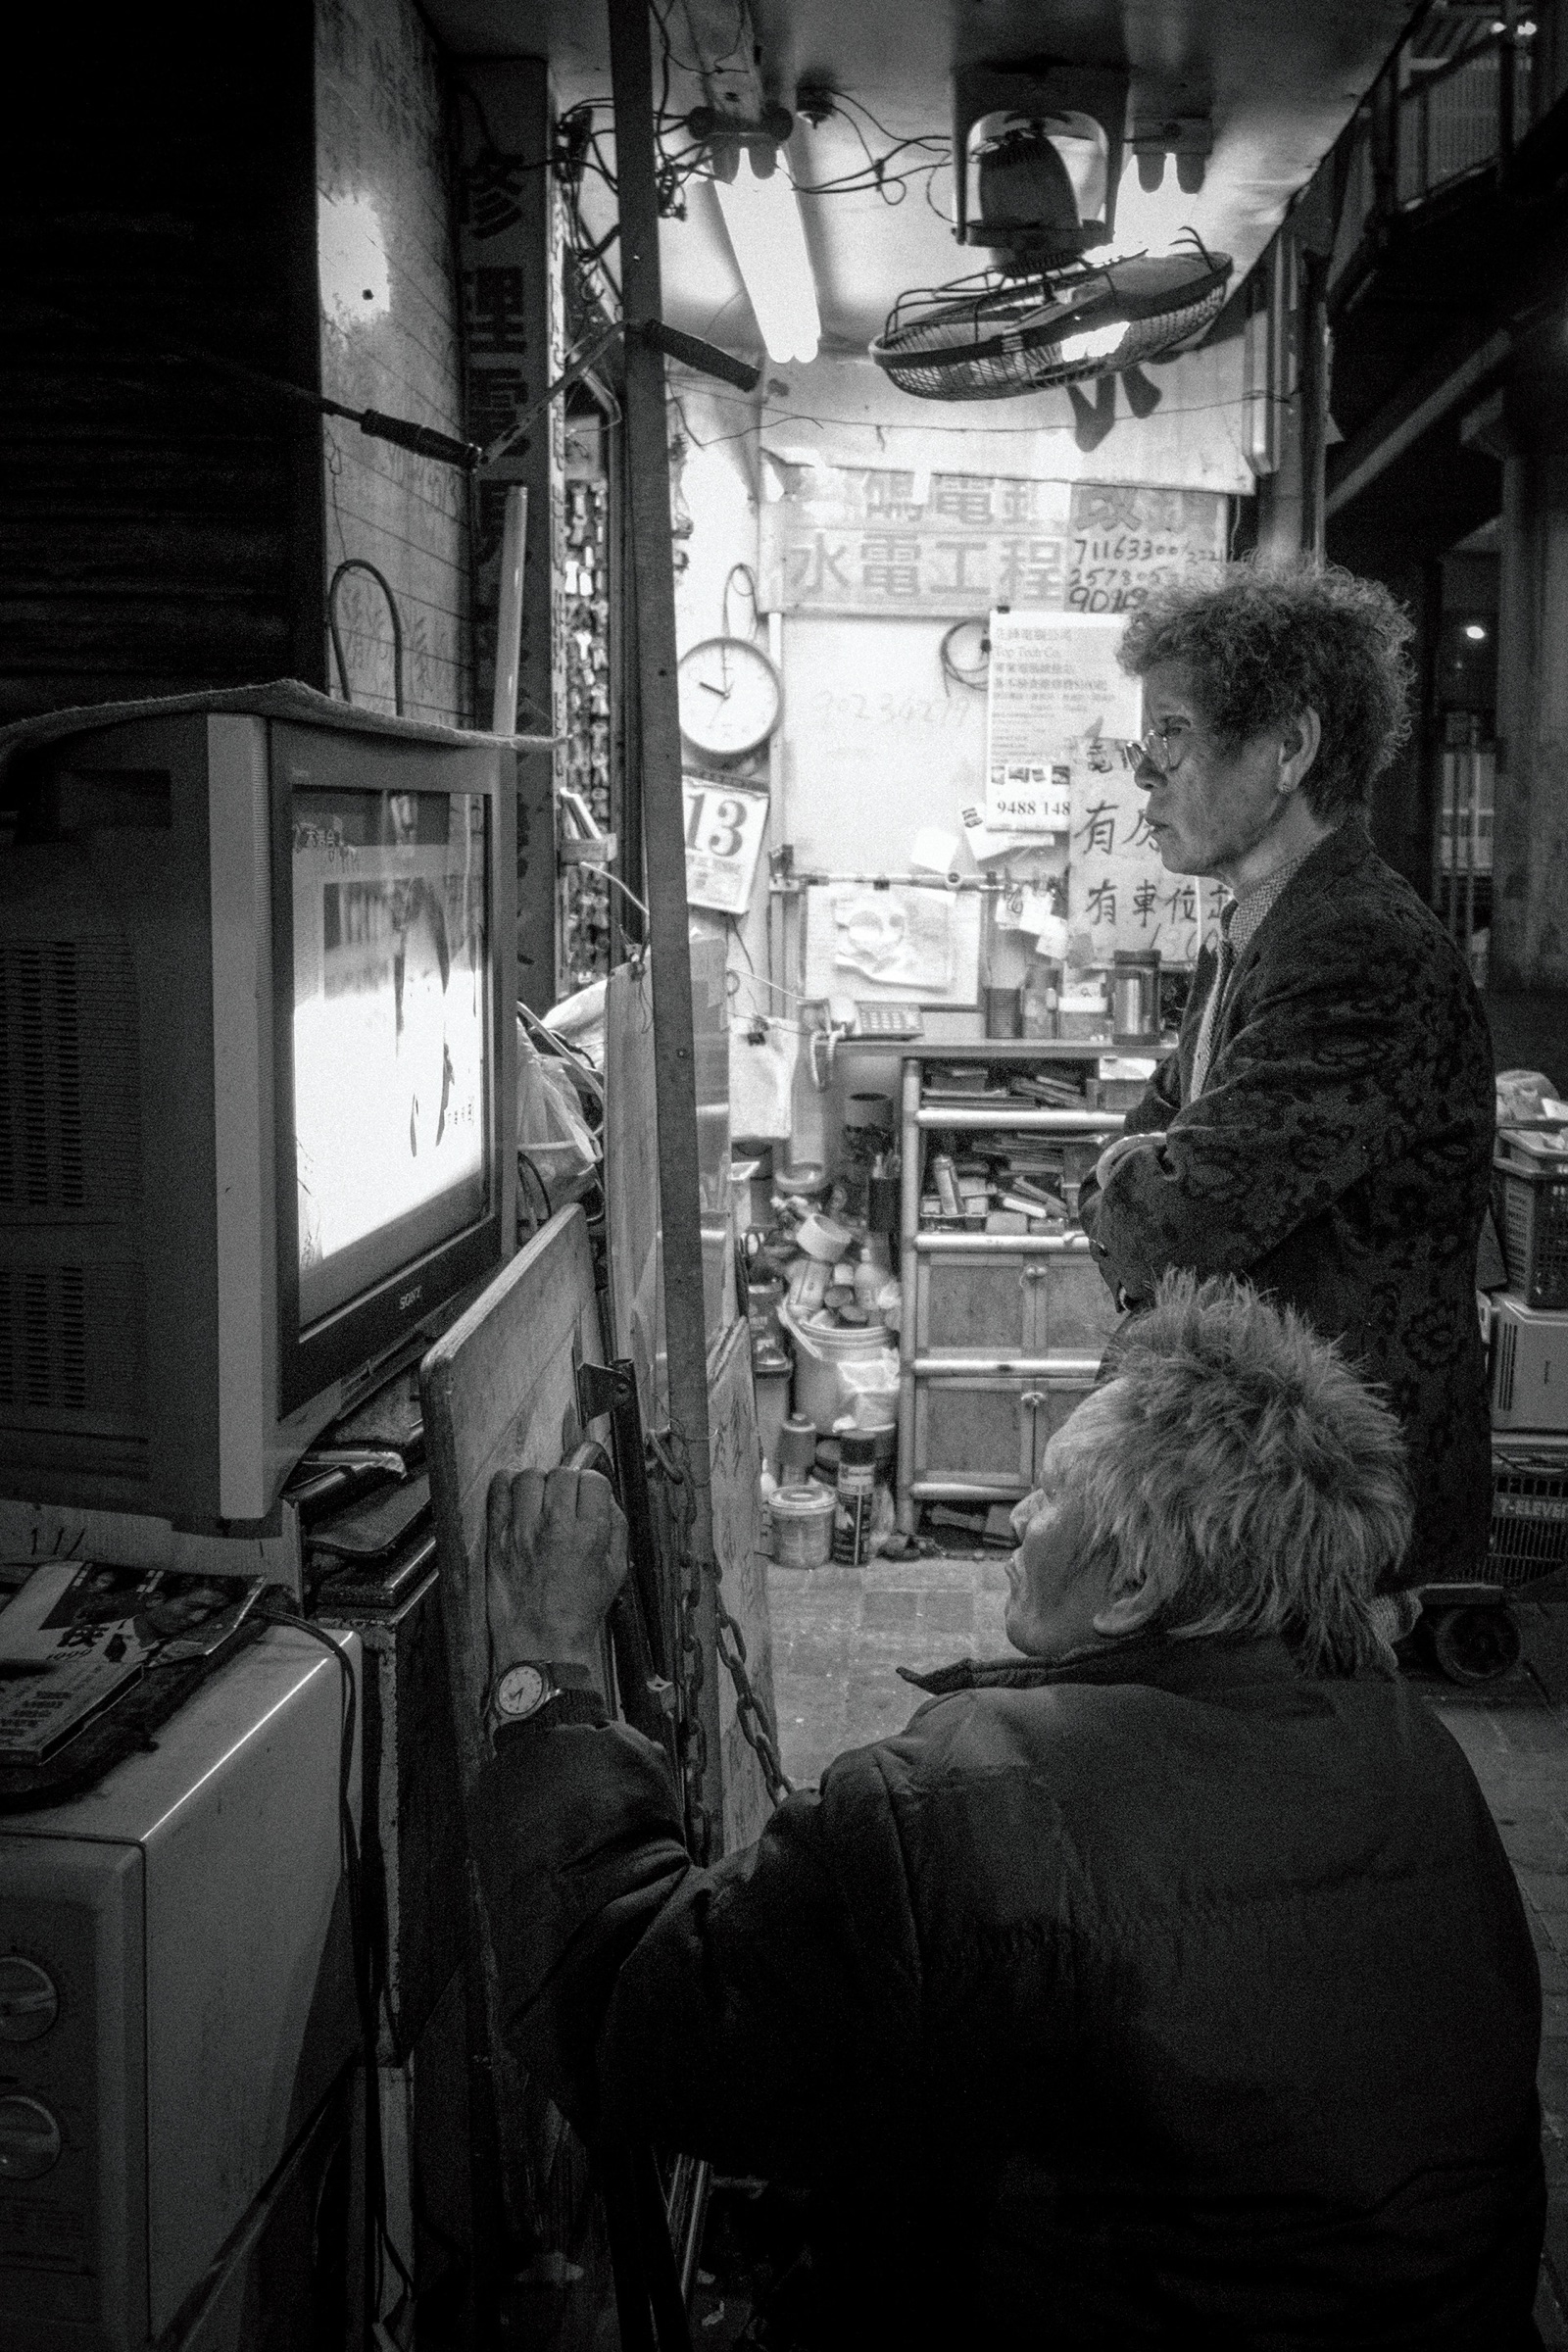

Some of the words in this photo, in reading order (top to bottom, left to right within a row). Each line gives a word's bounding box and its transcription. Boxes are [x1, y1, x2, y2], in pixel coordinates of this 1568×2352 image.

[789, 530, 1063, 602] 水電工程
[686, 793, 748, 858] 13
[997, 800, 1037, 815] 9488
[399, 1285, 422, 1310] SONY
